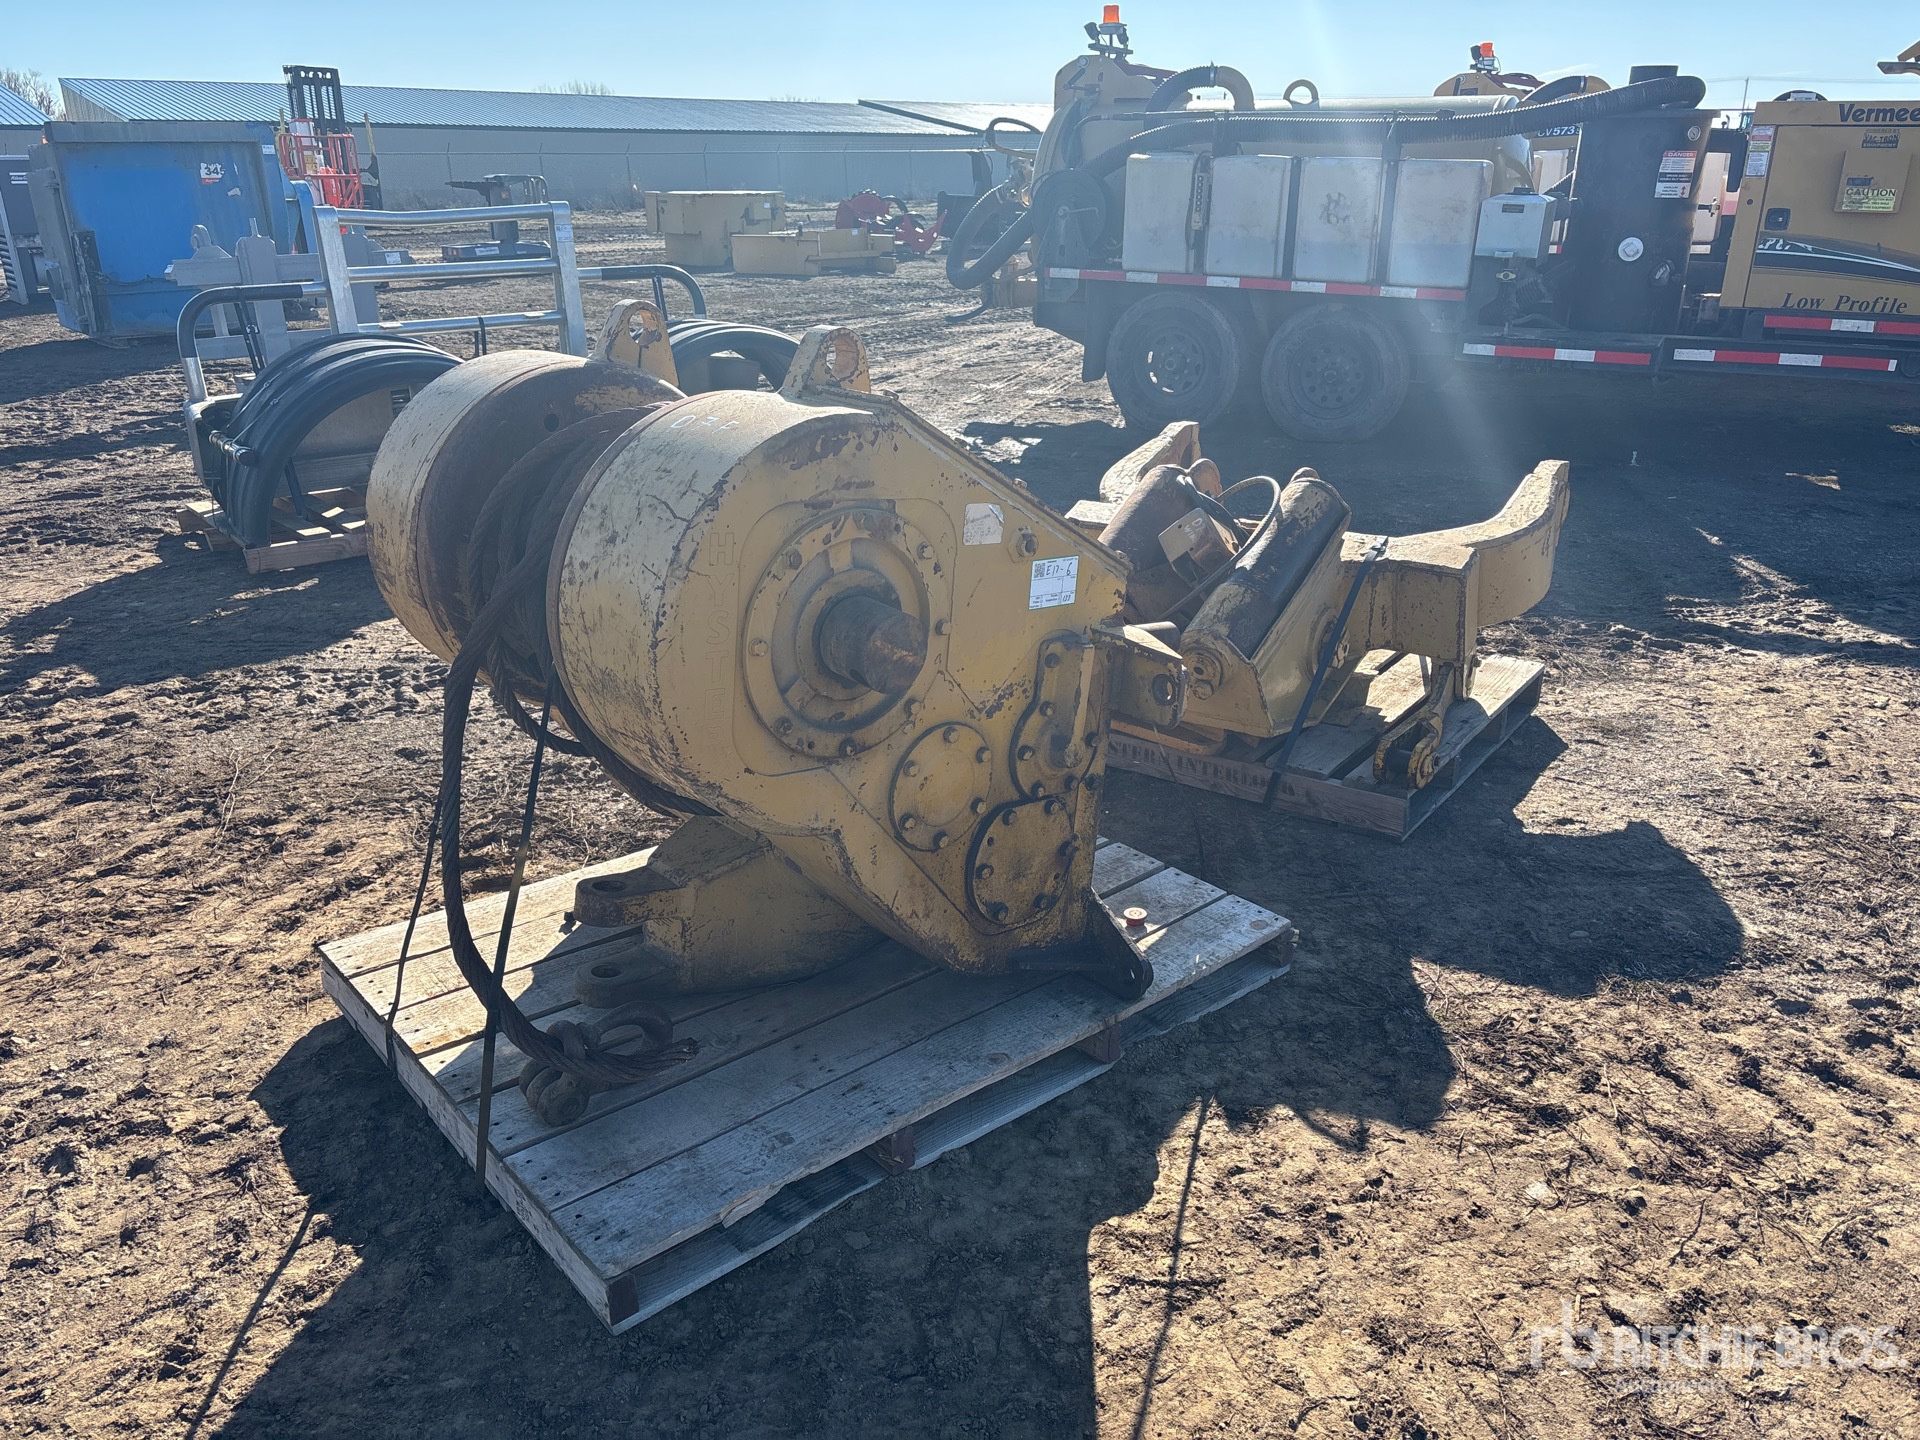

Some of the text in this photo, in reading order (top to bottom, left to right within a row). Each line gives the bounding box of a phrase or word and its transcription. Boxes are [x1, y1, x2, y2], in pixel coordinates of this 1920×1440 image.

[1846, 188, 1897, 197] CAUTION
[1782, 292, 1908, 315] Low Profile
[702, 532, 737, 748] HYSTER
